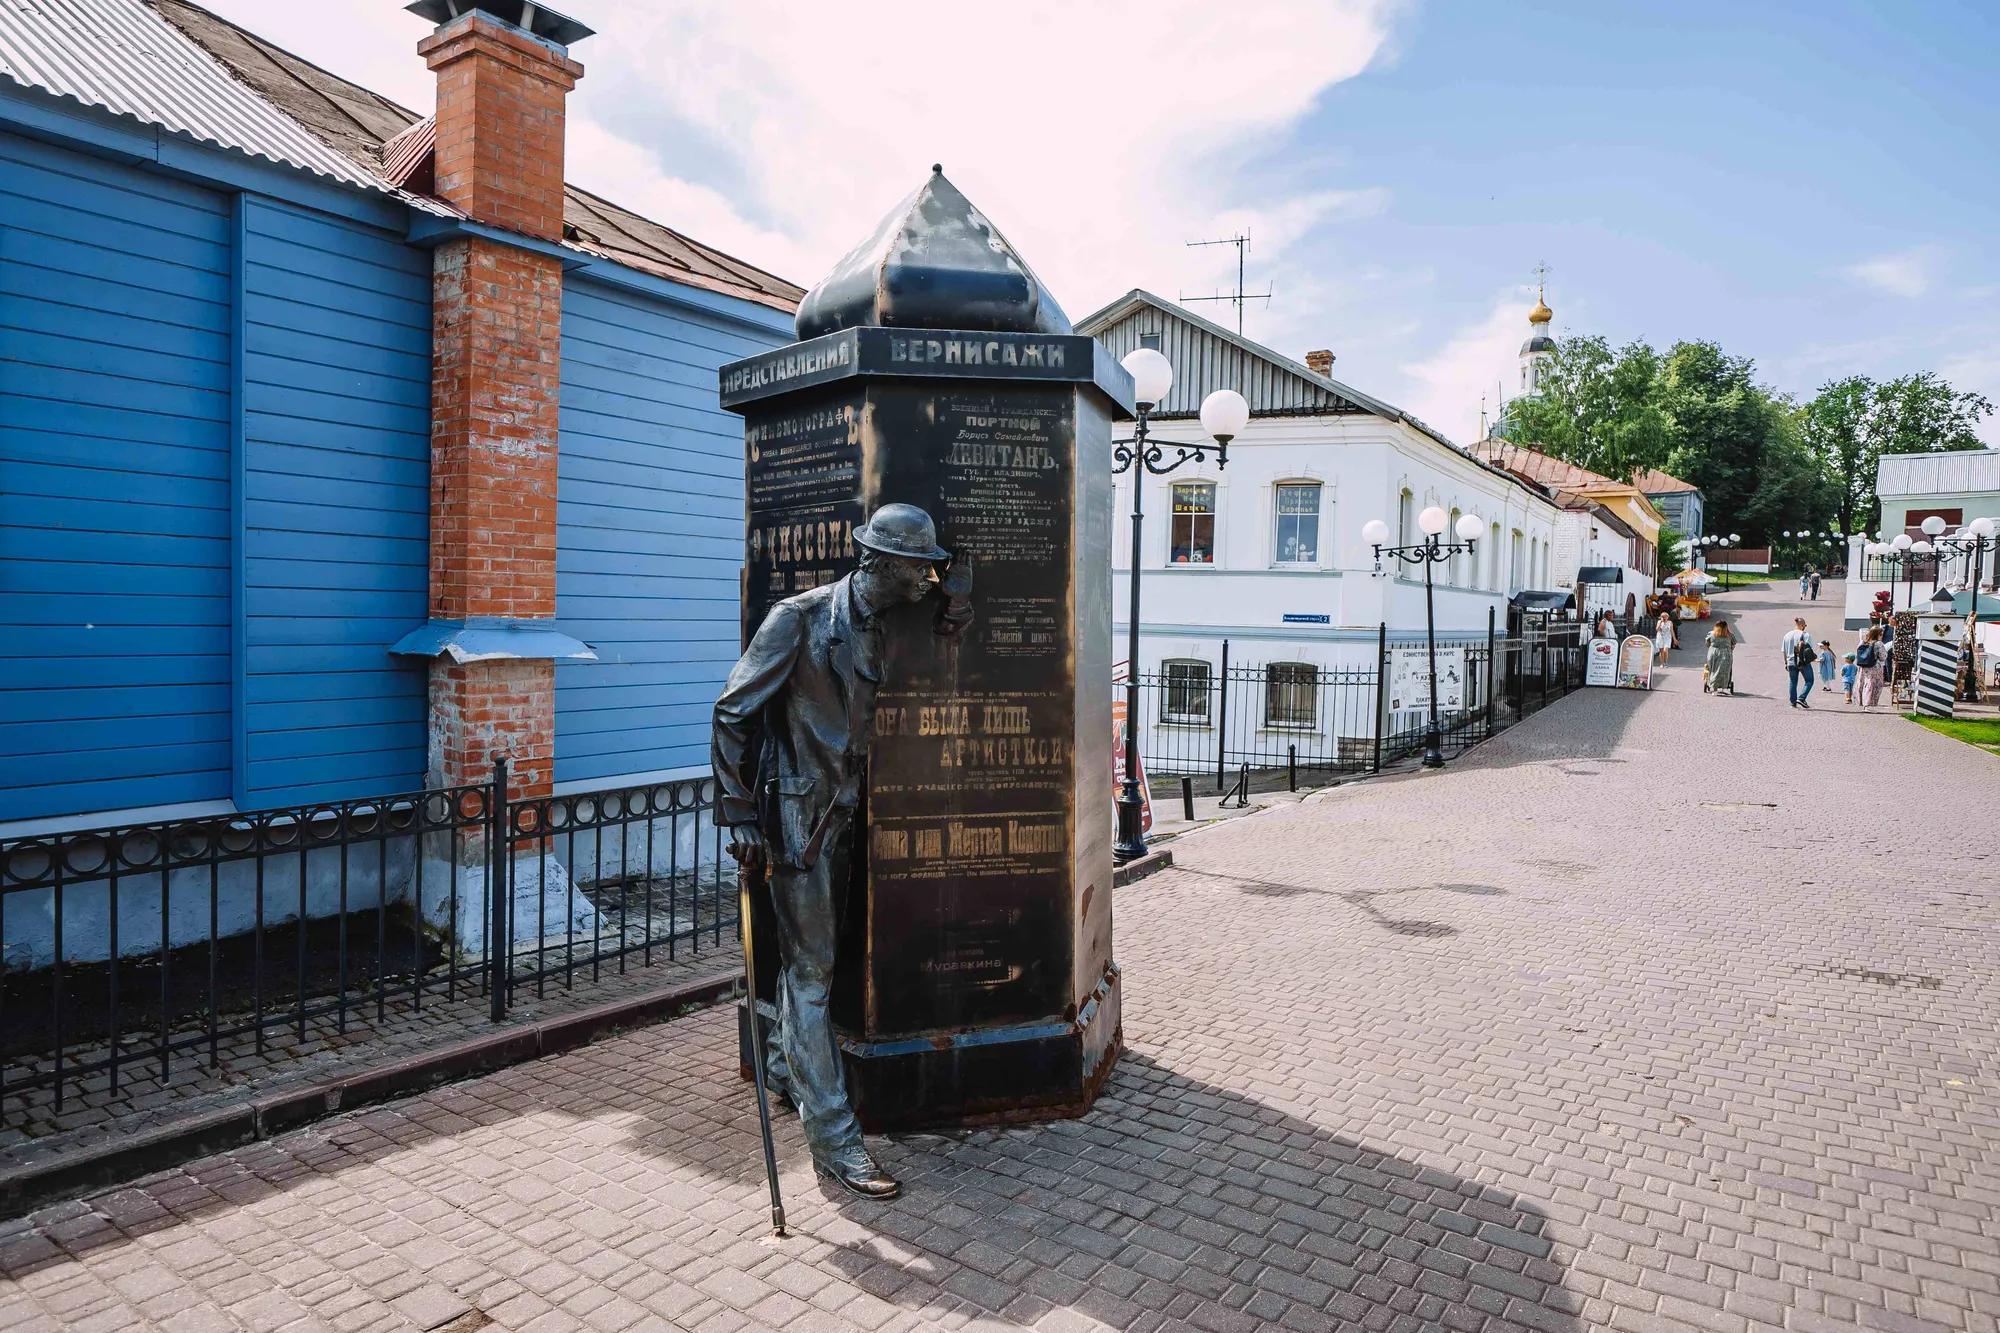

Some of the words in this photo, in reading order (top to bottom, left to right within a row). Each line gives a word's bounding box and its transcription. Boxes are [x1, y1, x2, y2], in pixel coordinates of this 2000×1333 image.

[725, 342, 849, 393] ПРЕДСТАВЛЕНИЯ
[891, 335, 1066, 369] ВЕРНИСАЖИ
[966, 415, 1041, 431] ПОРТНОЙ
[918, 706, 971, 736] БЫЛА
[983, 706, 1031, 734] ЛИШЬ
[948, 821, 1002, 858] Жертва
